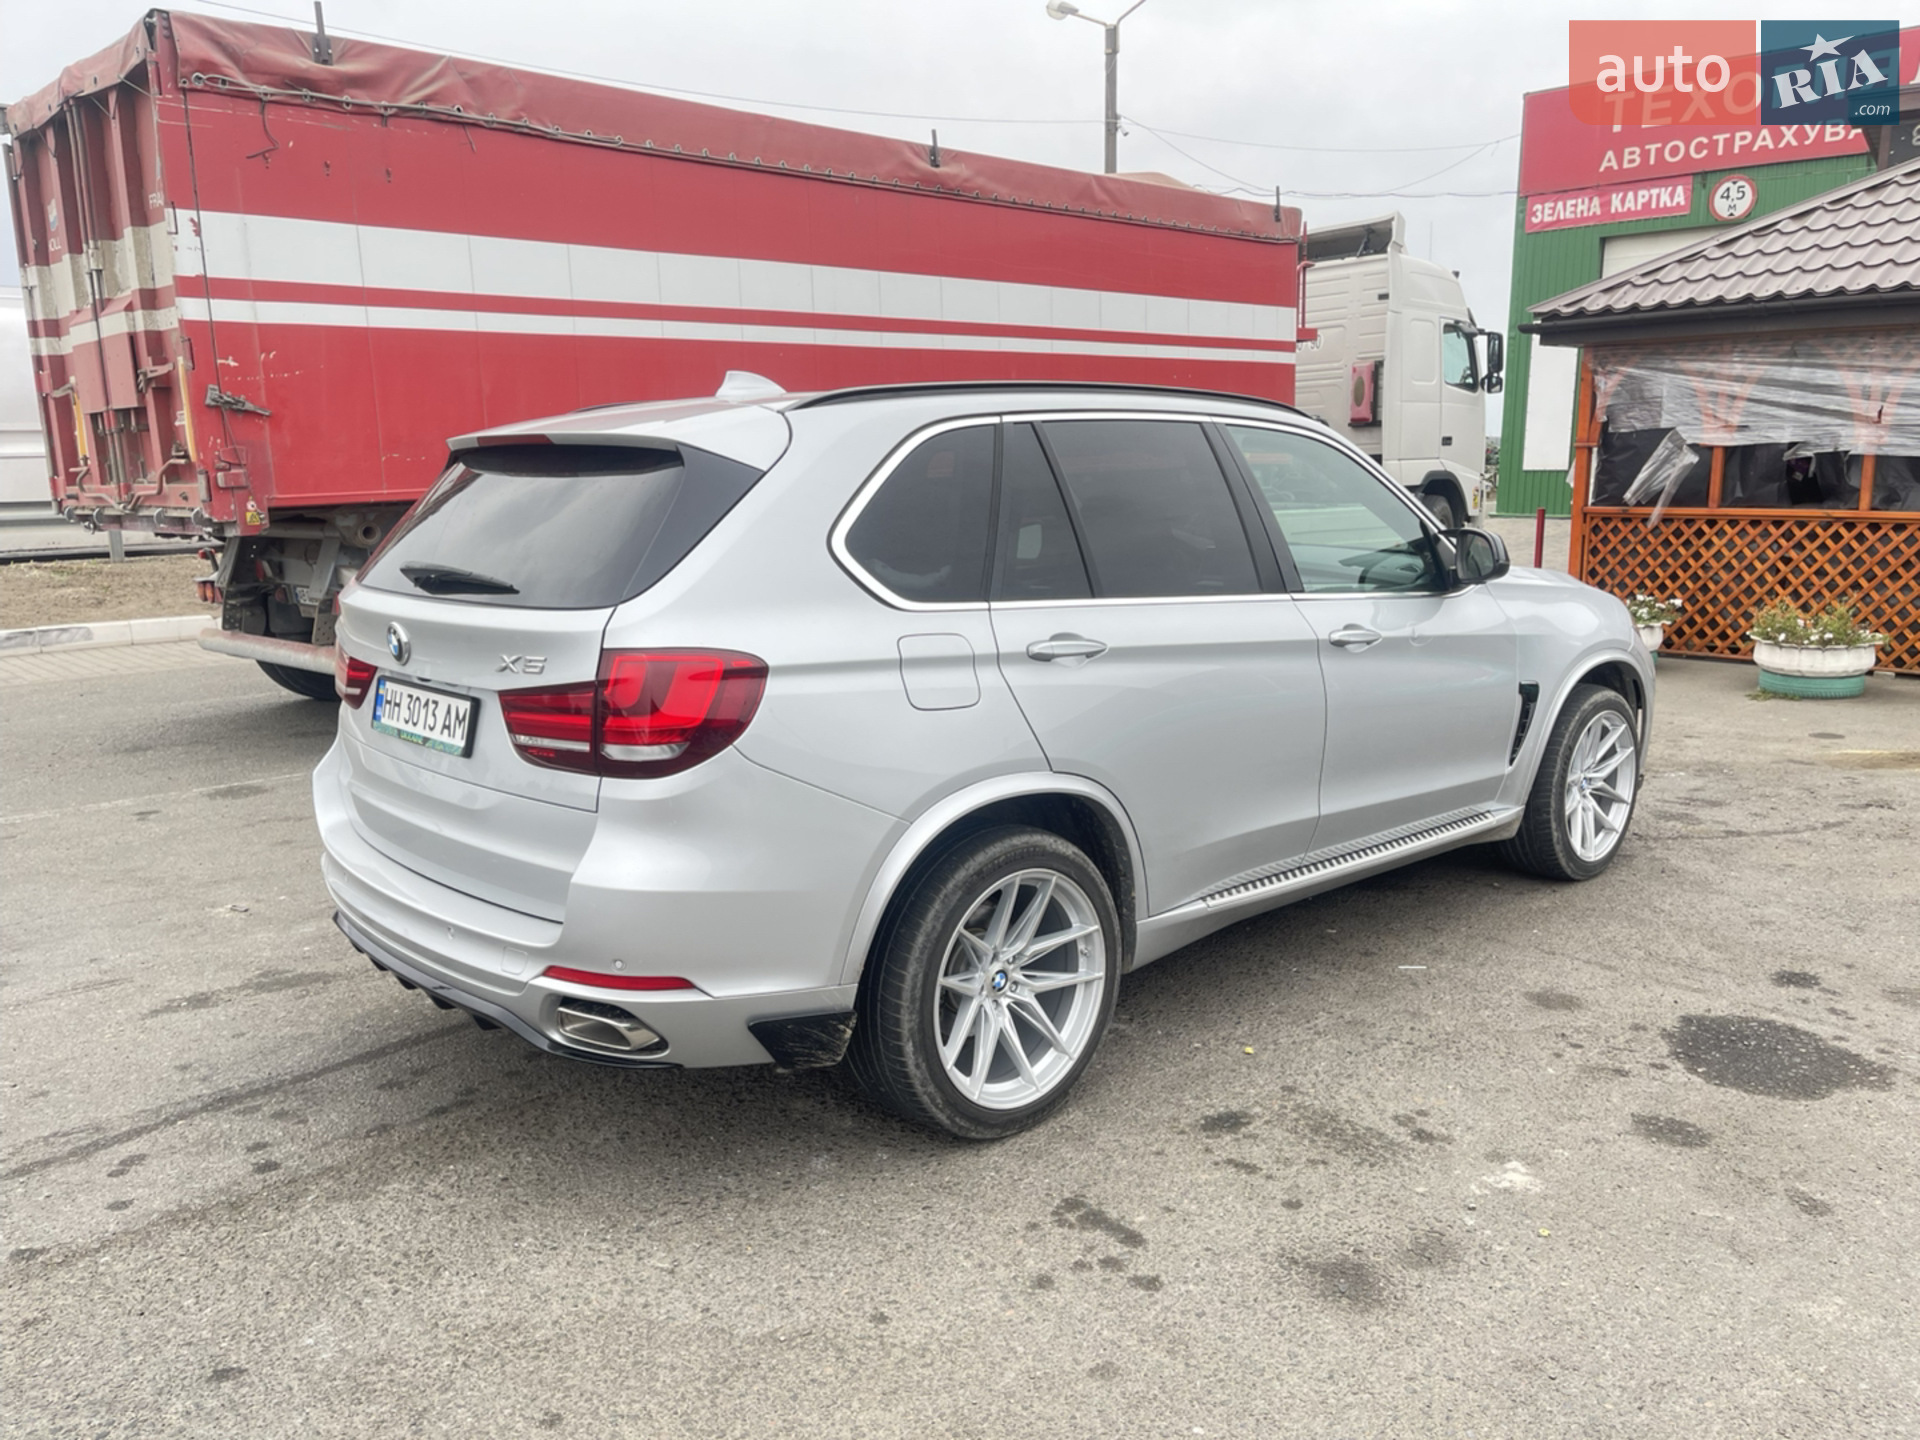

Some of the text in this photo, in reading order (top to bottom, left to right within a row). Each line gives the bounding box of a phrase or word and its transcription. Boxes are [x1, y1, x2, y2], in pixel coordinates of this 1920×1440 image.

[1531, 185, 1686, 223] ЗЕЛЕНА КАРТКА
[1720, 185, 1746, 202] 4,5
[495, 654, 548, 675] X5
[382, 687, 403, 722] HH
[404, 693, 439, 732] 3013
[440, 703, 468, 741] AM
